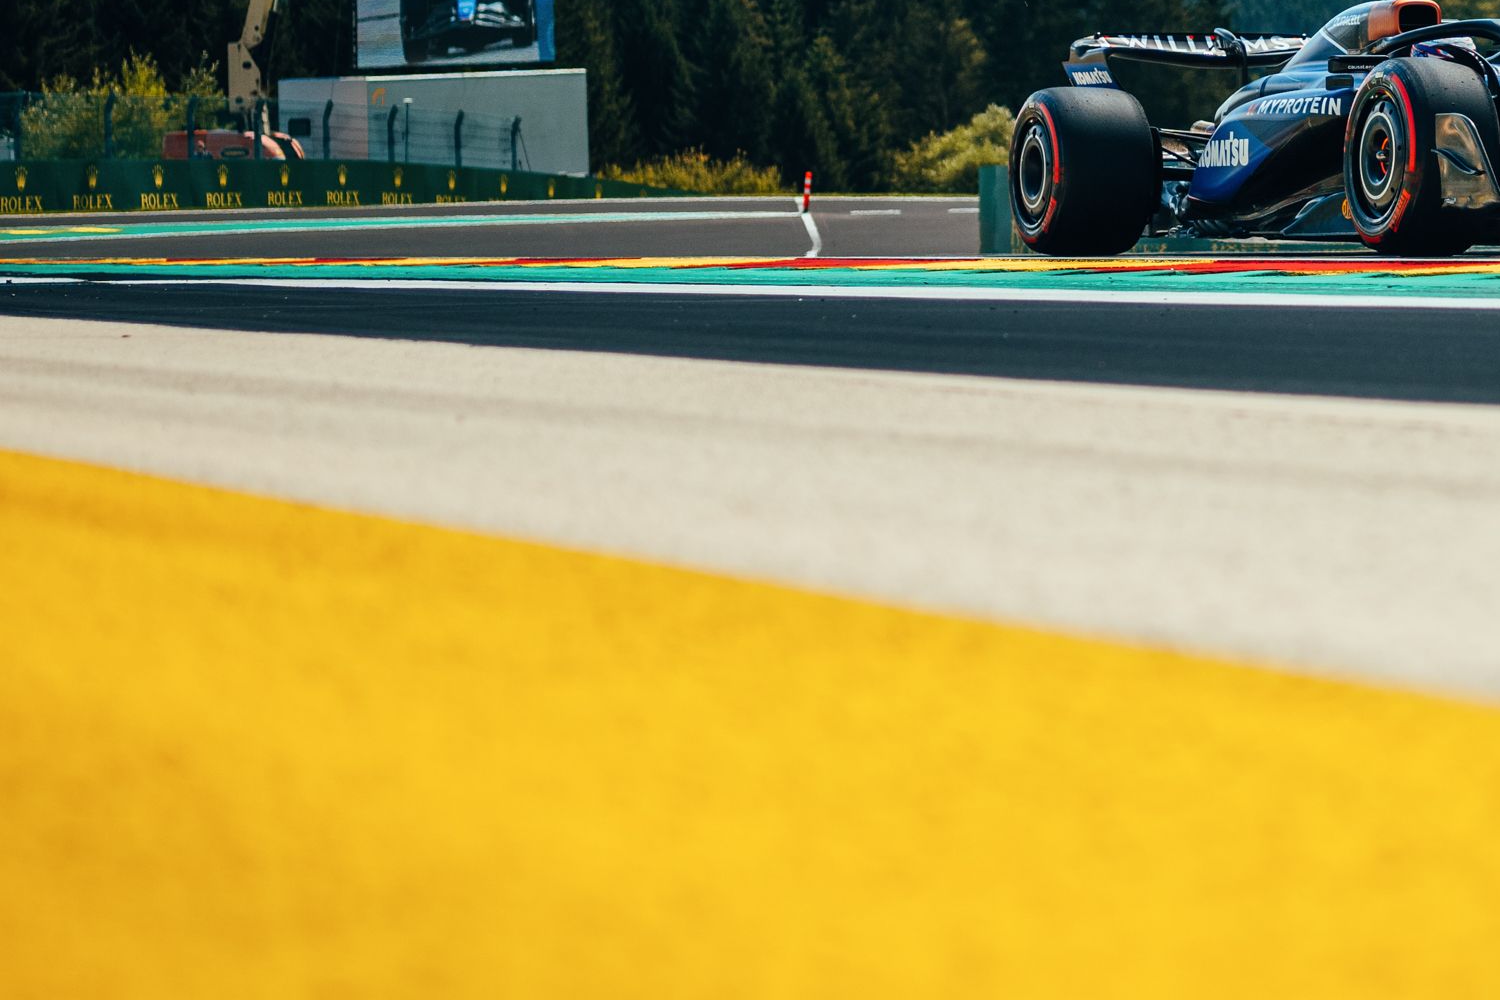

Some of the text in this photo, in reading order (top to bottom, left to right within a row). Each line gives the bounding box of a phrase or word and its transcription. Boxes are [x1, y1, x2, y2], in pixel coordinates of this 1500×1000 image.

[1118, 34, 1291, 56] WILLIMS
[1071, 67, 1113, 86] KOMATSU
[1257, 96, 1342, 115] MYPROTEIN
[0, 195, 43, 212] ROLEX
[73, 194, 113, 210] ROLEX
[140, 192, 179, 209] ROLEX
[206, 192, 242, 207] ROLEX
[267, 191, 303, 206] ROLEX
[326, 190, 360, 206] ROLEX
